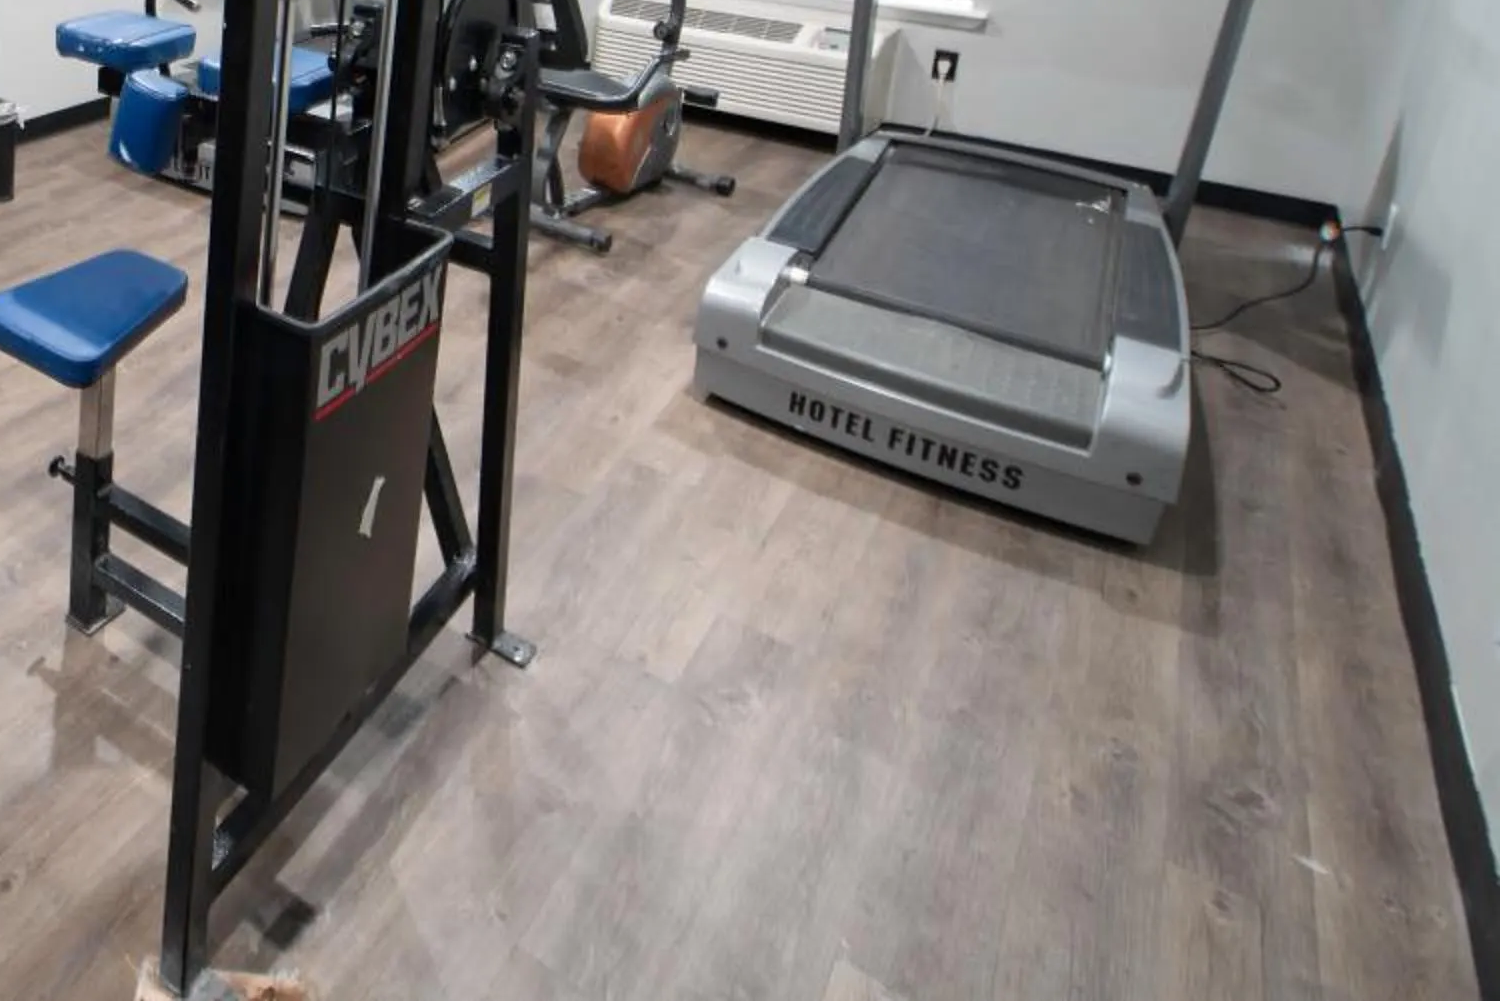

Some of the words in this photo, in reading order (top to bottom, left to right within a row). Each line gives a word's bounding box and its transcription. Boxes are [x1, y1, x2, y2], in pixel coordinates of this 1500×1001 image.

[316, 265, 442, 409] CYBEX
[788, 391, 875, 442] HOTEL
[888, 428, 1025, 490] FITNESS
